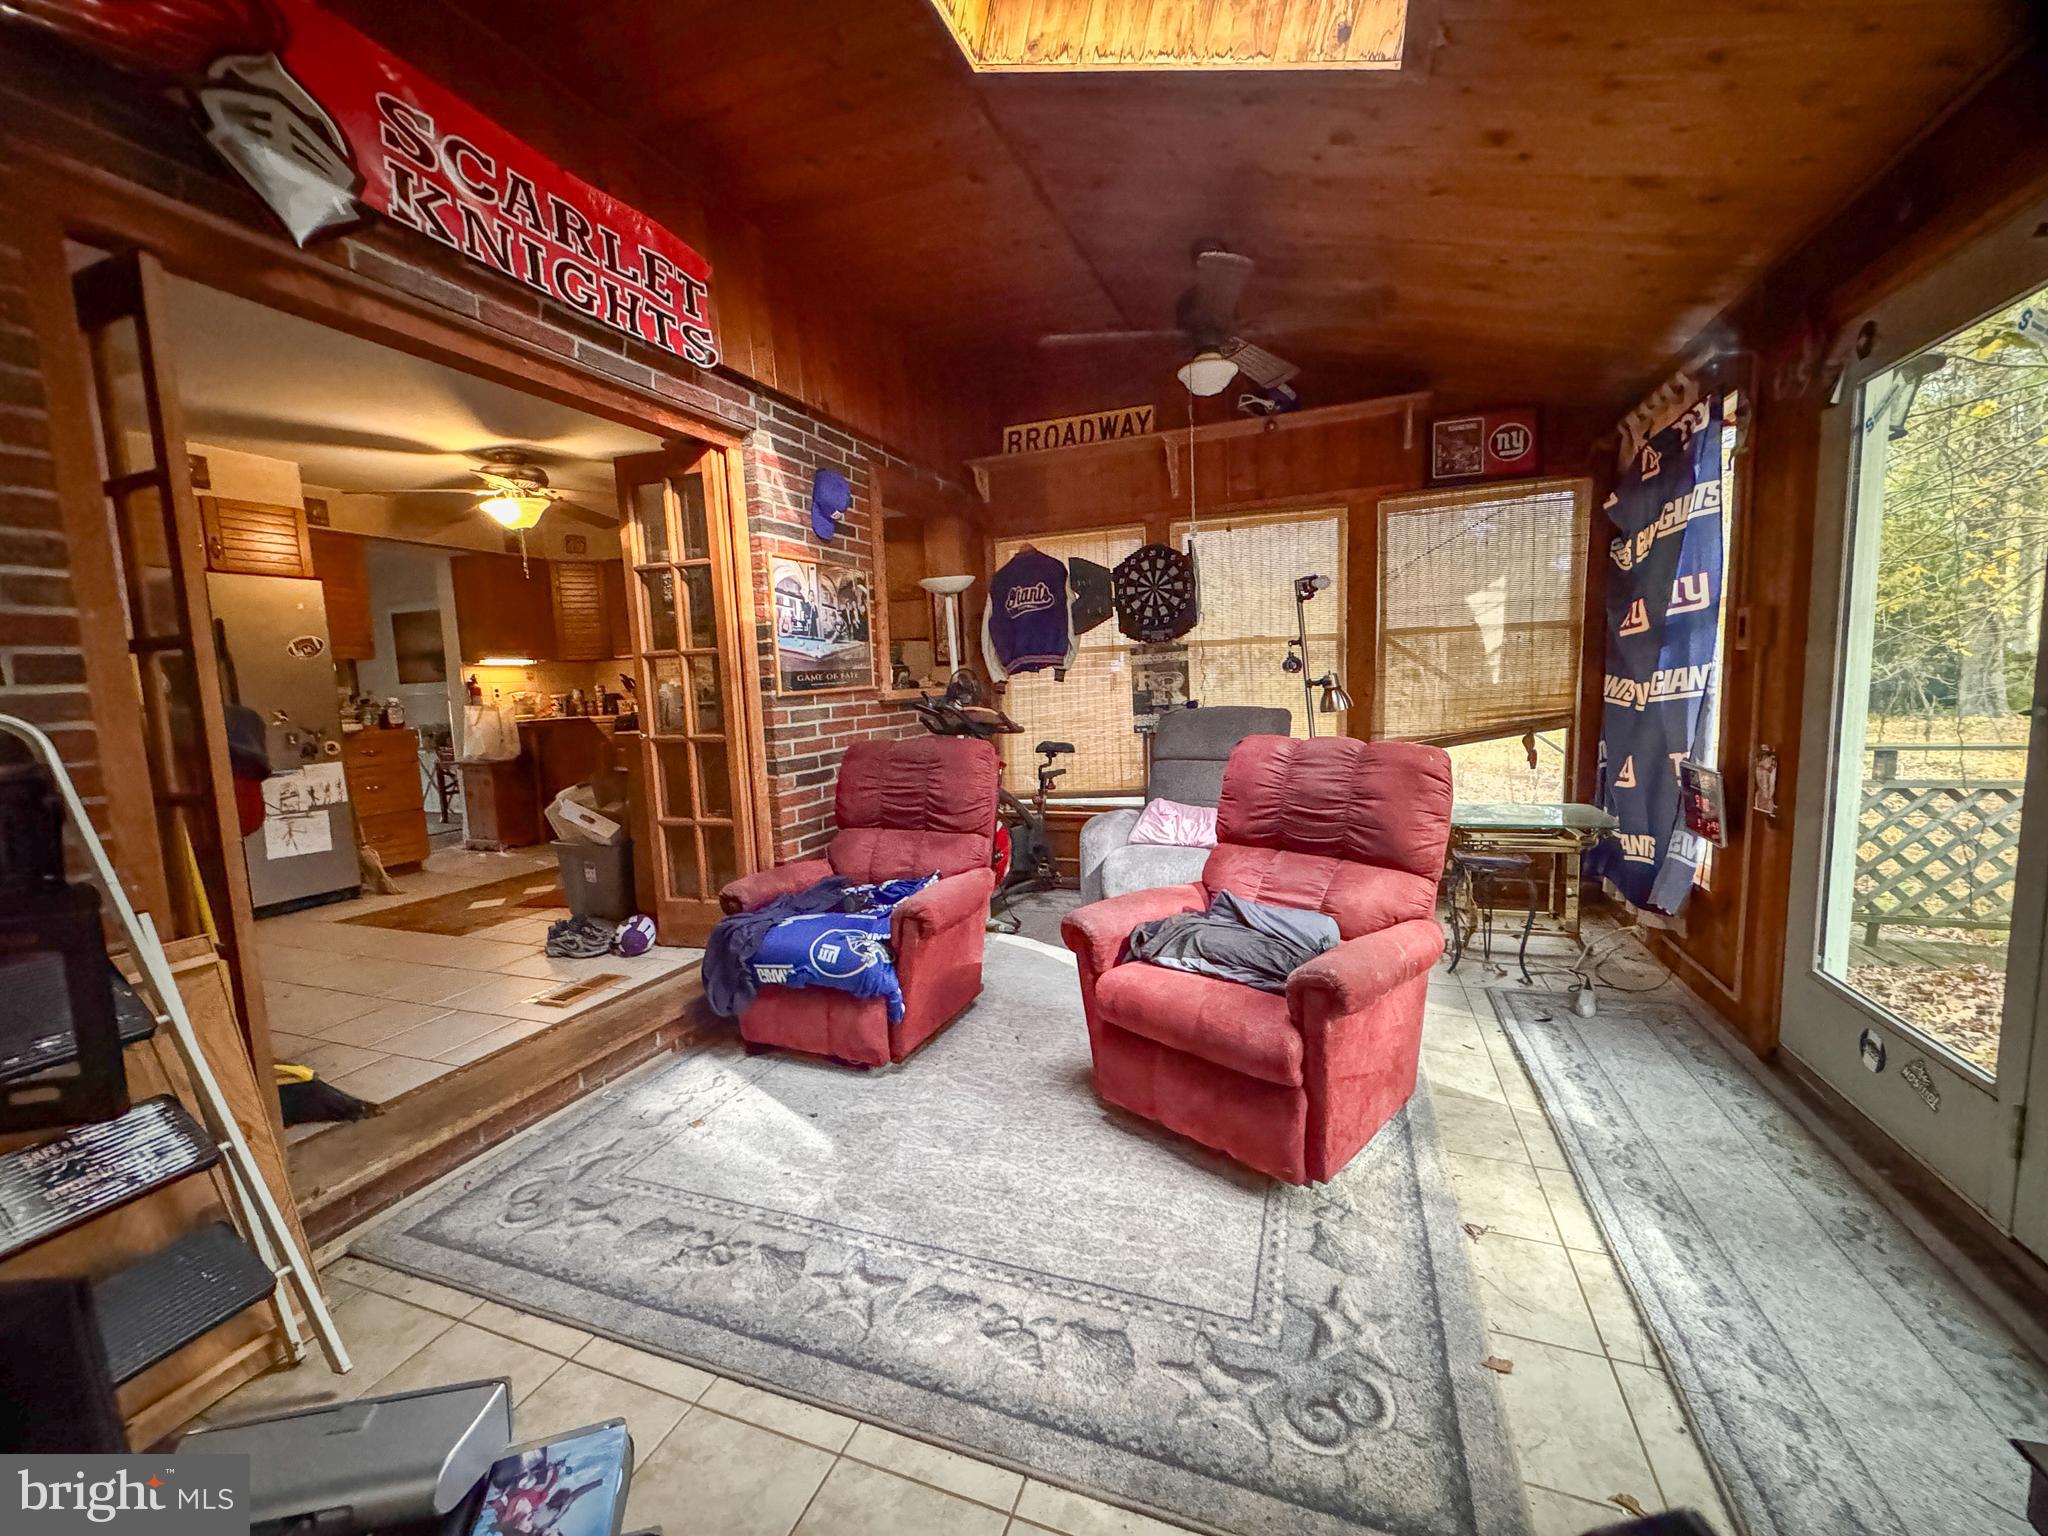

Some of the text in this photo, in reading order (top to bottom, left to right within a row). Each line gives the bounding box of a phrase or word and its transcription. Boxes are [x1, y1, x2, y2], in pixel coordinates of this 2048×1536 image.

[376, 92, 707, 322] SCARLET
[383, 155, 719, 369] KNIGHTS
[1007, 409, 1153, 454] BROADWAY
[1650, 664, 1711, 696] GIAN
